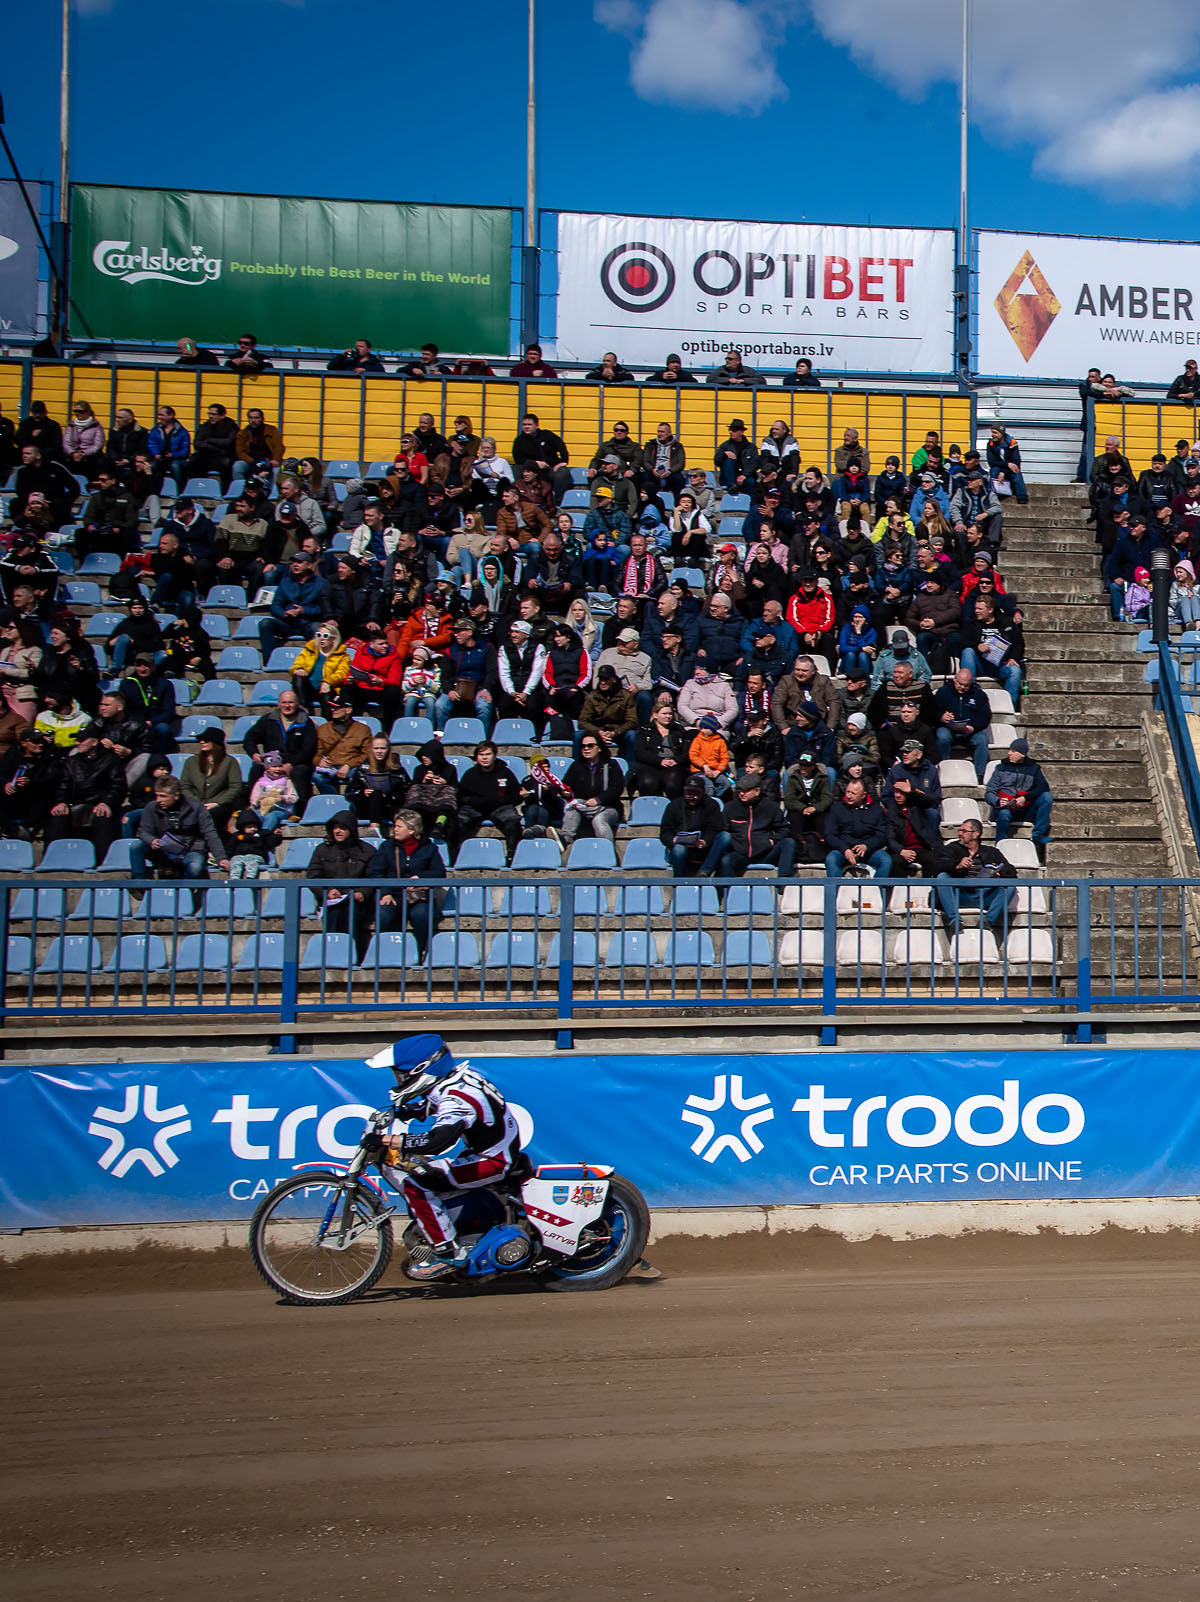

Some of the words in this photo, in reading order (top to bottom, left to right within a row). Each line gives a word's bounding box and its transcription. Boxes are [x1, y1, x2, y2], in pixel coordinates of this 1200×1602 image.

[93, 240, 222, 285] Carlsberg
[230, 260, 297, 279] Probably
[301, 263, 325, 277] the
[329, 265, 361, 279] Best
[366, 266, 399, 280] Beer
[403, 268, 417, 282] in
[421, 269, 444, 283] the
[447, 271, 491, 286] World
[693, 250, 913, 303] OPTIBET
[696, 301, 813, 316] SPORTA
[837, 305, 910, 320] BĀRS
[1074, 284, 1193, 321] AMBER
[681, 339, 834, 357] optibetsportabars.lv
[791, 1079, 1085, 1147] trodo
[809, 1165, 868, 1186] CAR
[876, 1163, 969, 1184] PARTS
[977, 1160, 1082, 1183] ONLINE
[543, 1230, 576, 1246] LATVIA
